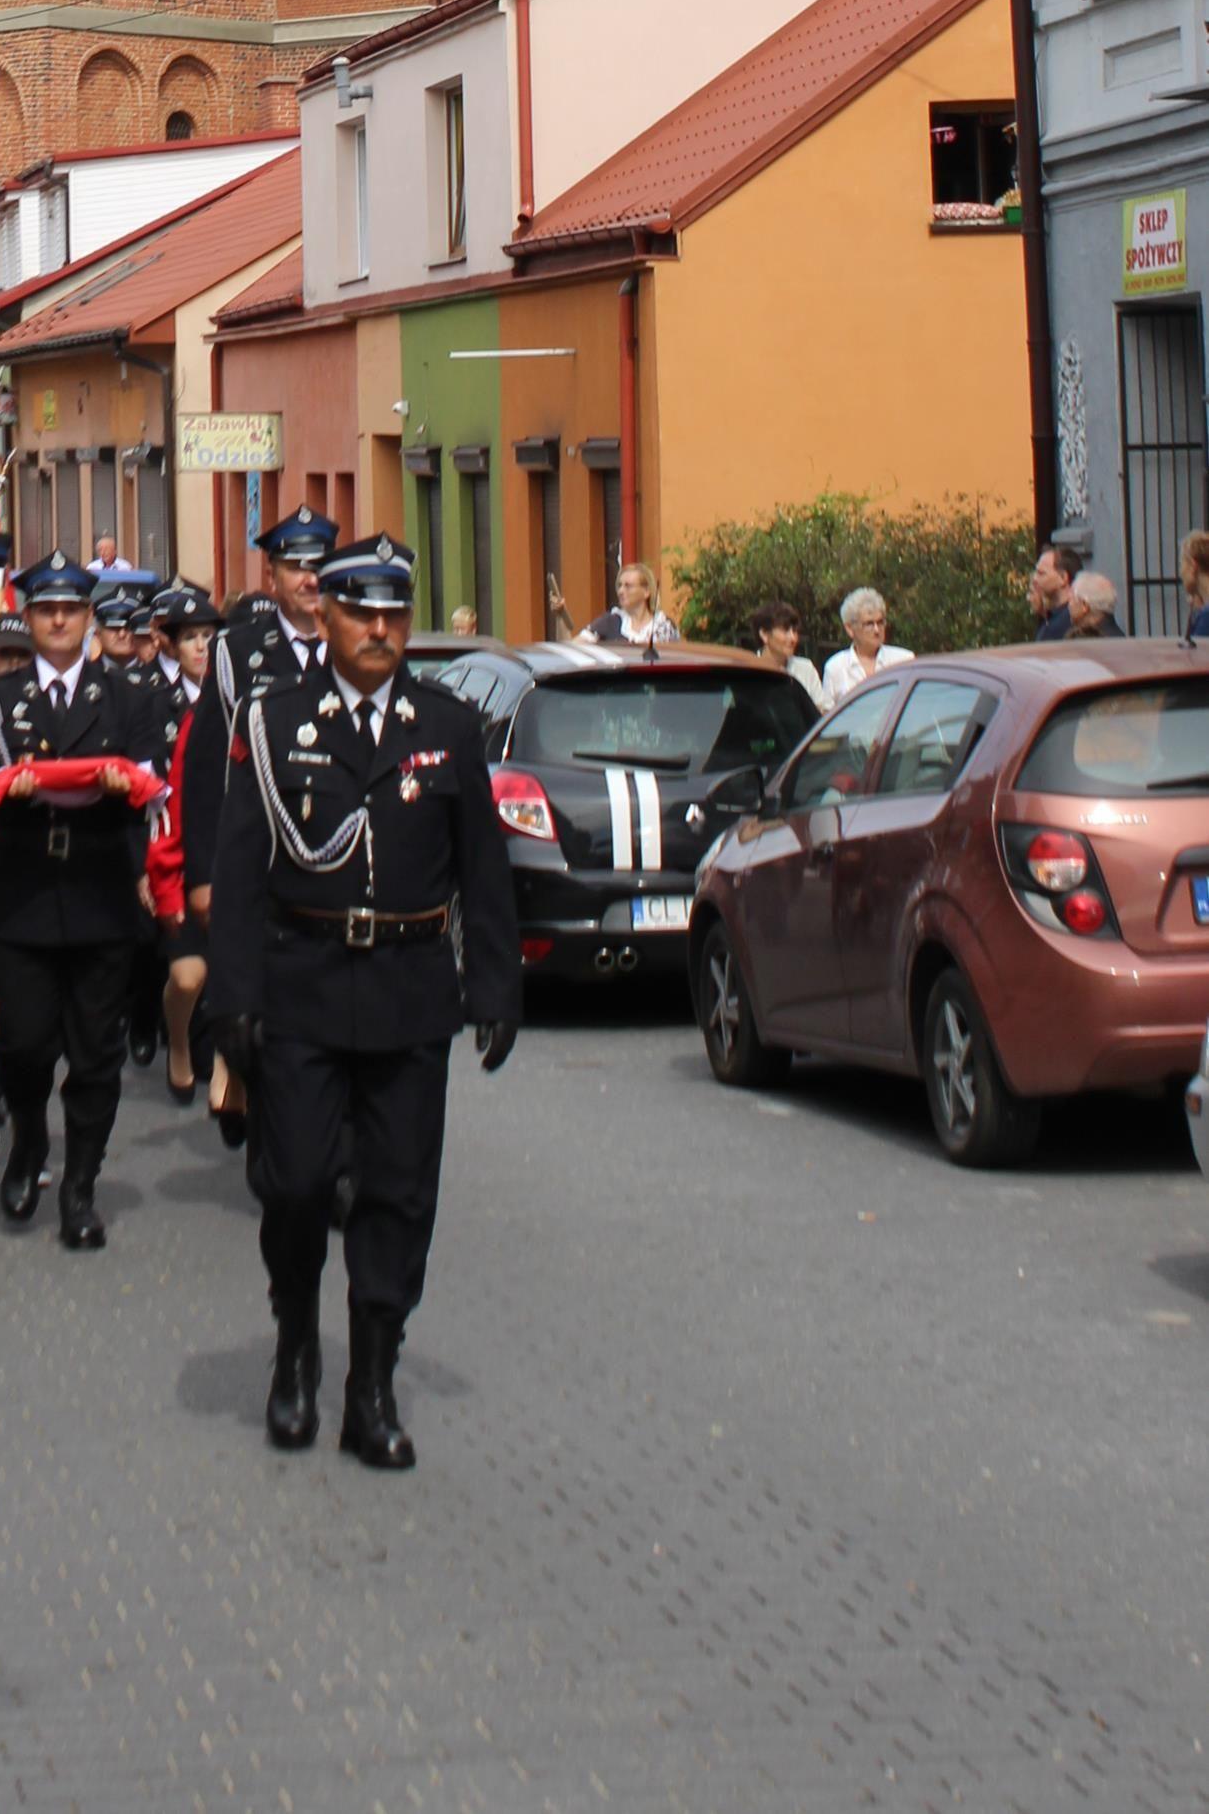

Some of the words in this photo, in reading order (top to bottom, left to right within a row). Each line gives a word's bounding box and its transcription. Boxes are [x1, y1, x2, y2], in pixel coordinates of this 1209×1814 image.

[1138, 208, 1168, 234] SKLEP
[1125, 240, 1183, 271] SPOŻYWCZY
[183, 415, 262, 431] Zabawki
